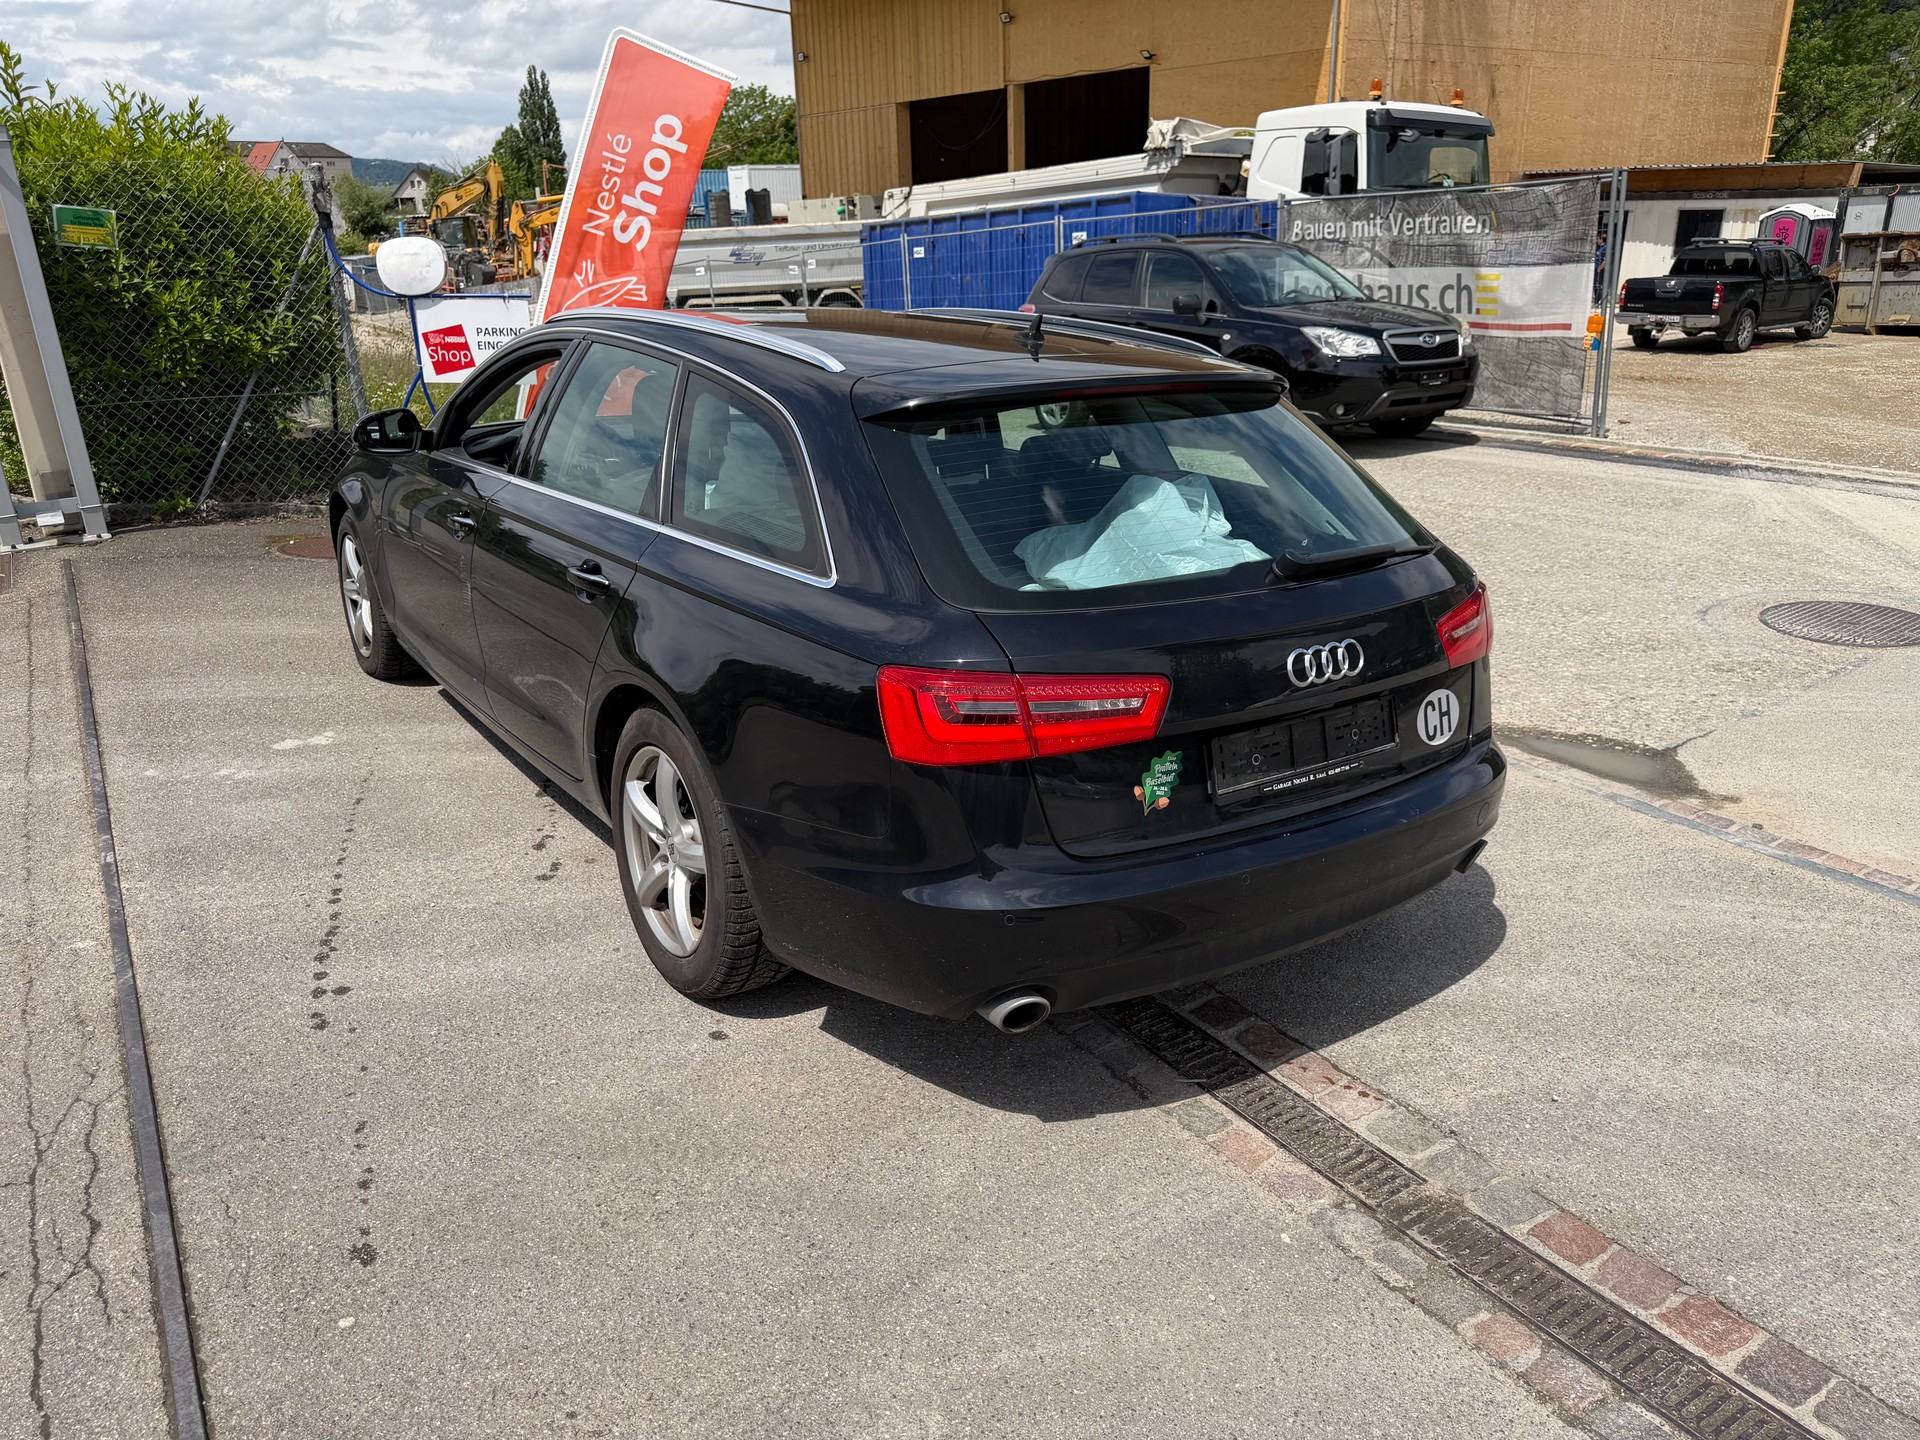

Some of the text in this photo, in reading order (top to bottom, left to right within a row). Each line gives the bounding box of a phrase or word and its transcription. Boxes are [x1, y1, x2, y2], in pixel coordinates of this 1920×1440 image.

[583, 132, 632, 236] Nestlé
[613, 114, 689, 252] Shop
[1291, 219, 1347, 242] Bauen
[1352, 213, 1384, 237] mit
[476, 327, 526, 337] PARKING
[427, 346, 471, 366] Shop
[1423, 693, 1452, 742] CH
[1145, 772, 1176, 787] Baselbiet
[1154, 762, 1178, 773] Pratteln
